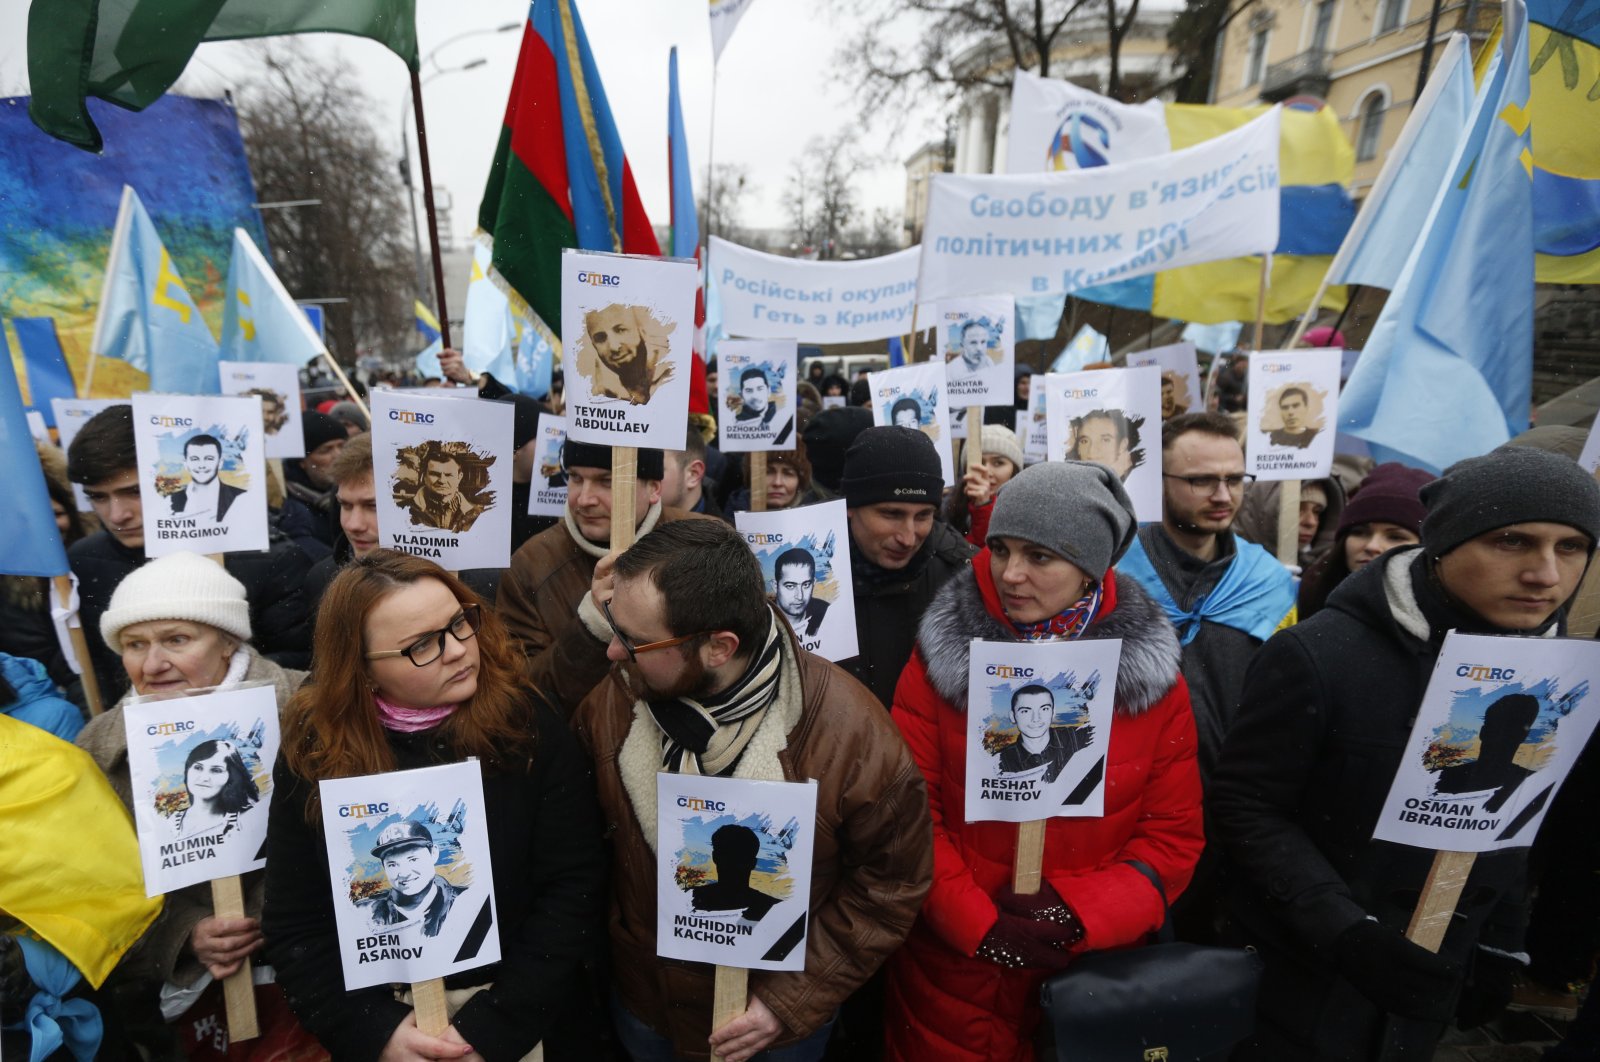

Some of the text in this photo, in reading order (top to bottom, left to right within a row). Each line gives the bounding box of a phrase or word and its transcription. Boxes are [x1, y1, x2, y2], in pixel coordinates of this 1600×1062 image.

[970, 189, 1116, 221] Свободу
[936, 231, 1123, 258] політичних
[721, 267, 833, 303] Російські
[1032, 275, 1049, 292] в
[753, 299, 916, 329] Геть з Криму!
[574, 405, 626, 421] TEYMUR
[575, 418, 650, 434] ABDULLAEV
[726, 424, 771, 433] DZHOKHAR
[1256, 453, 1295, 462] REDVAN
[1256, 461, 1318, 471] SULEYMANOV
[901, 487, 927, 496] Columbia
[157, 519, 196, 529] ERVIN
[157, 526, 229, 540] IBRAGIMOV
[392, 534, 460, 548] VLADIMIR
[981, 778, 1036, 791] RESHAT
[980, 790, 1041, 801] AMETOV
[1404, 797, 1475, 817] OSMAN
[1398, 810, 1501, 831] IBRAGIMOV
[160, 833, 225, 857] MUMINE
[161, 848, 216, 870] ALIEVA
[674, 914, 753, 936] MUHIDDIN
[356, 934, 401, 951] EDEM
[673, 926, 736, 946] KACHOK
[358, 946, 423, 965] ASANOV
